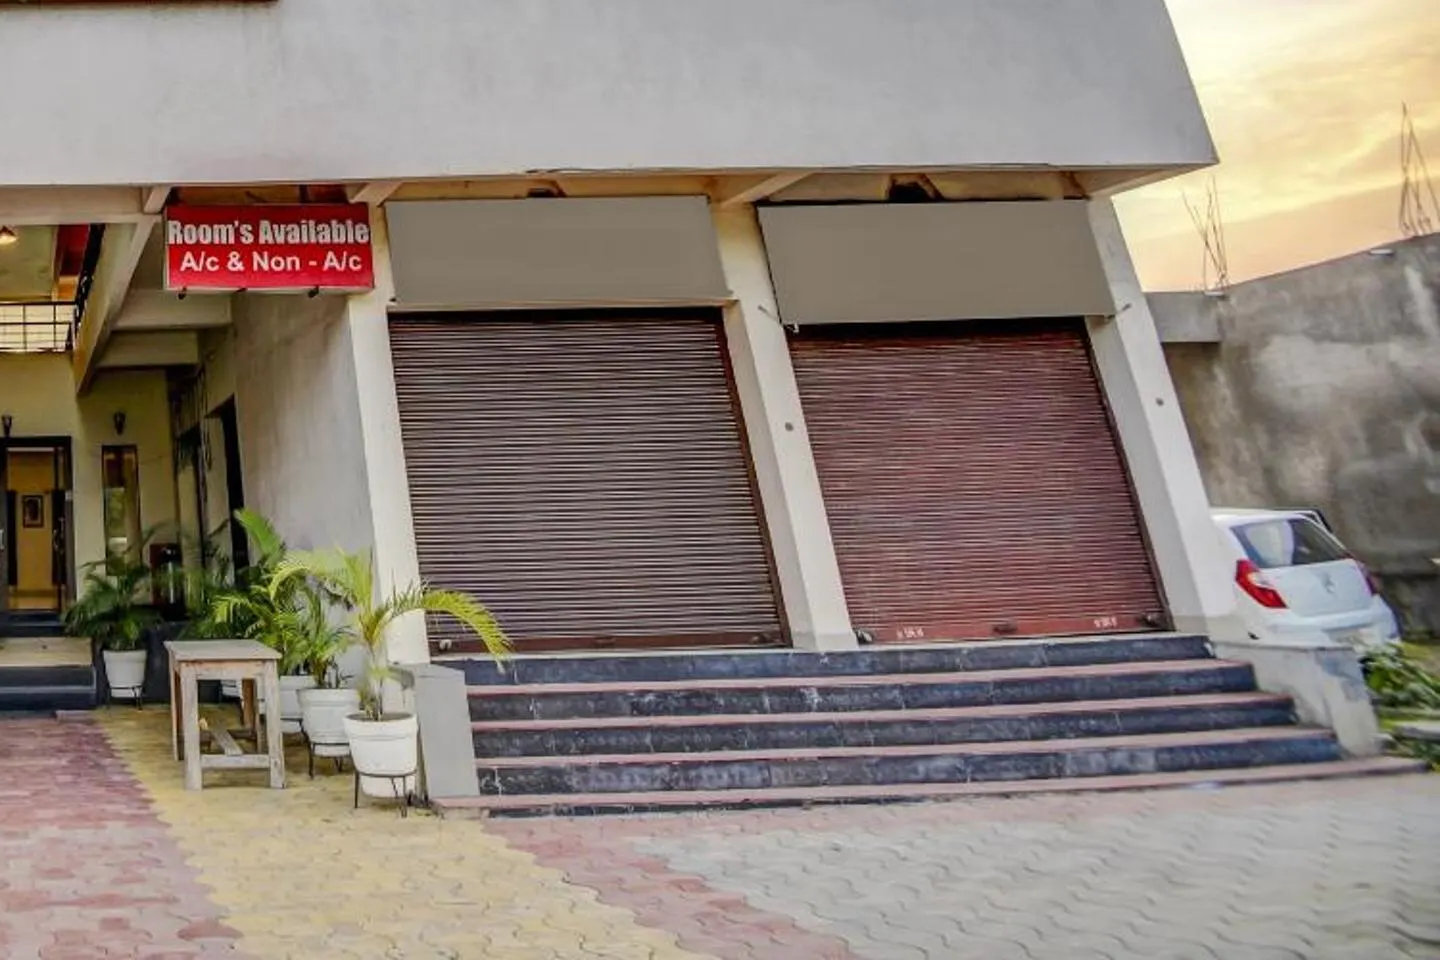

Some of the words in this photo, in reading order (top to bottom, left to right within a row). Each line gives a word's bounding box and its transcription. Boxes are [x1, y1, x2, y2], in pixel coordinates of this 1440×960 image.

[168, 220, 254, 244] Room's
[259, 219, 369, 244] Available
[180, 251, 220, 272] A/c
[227, 251, 245, 271] &
[252, 251, 301, 271] Non
[322, 250, 362, 271] A/c
